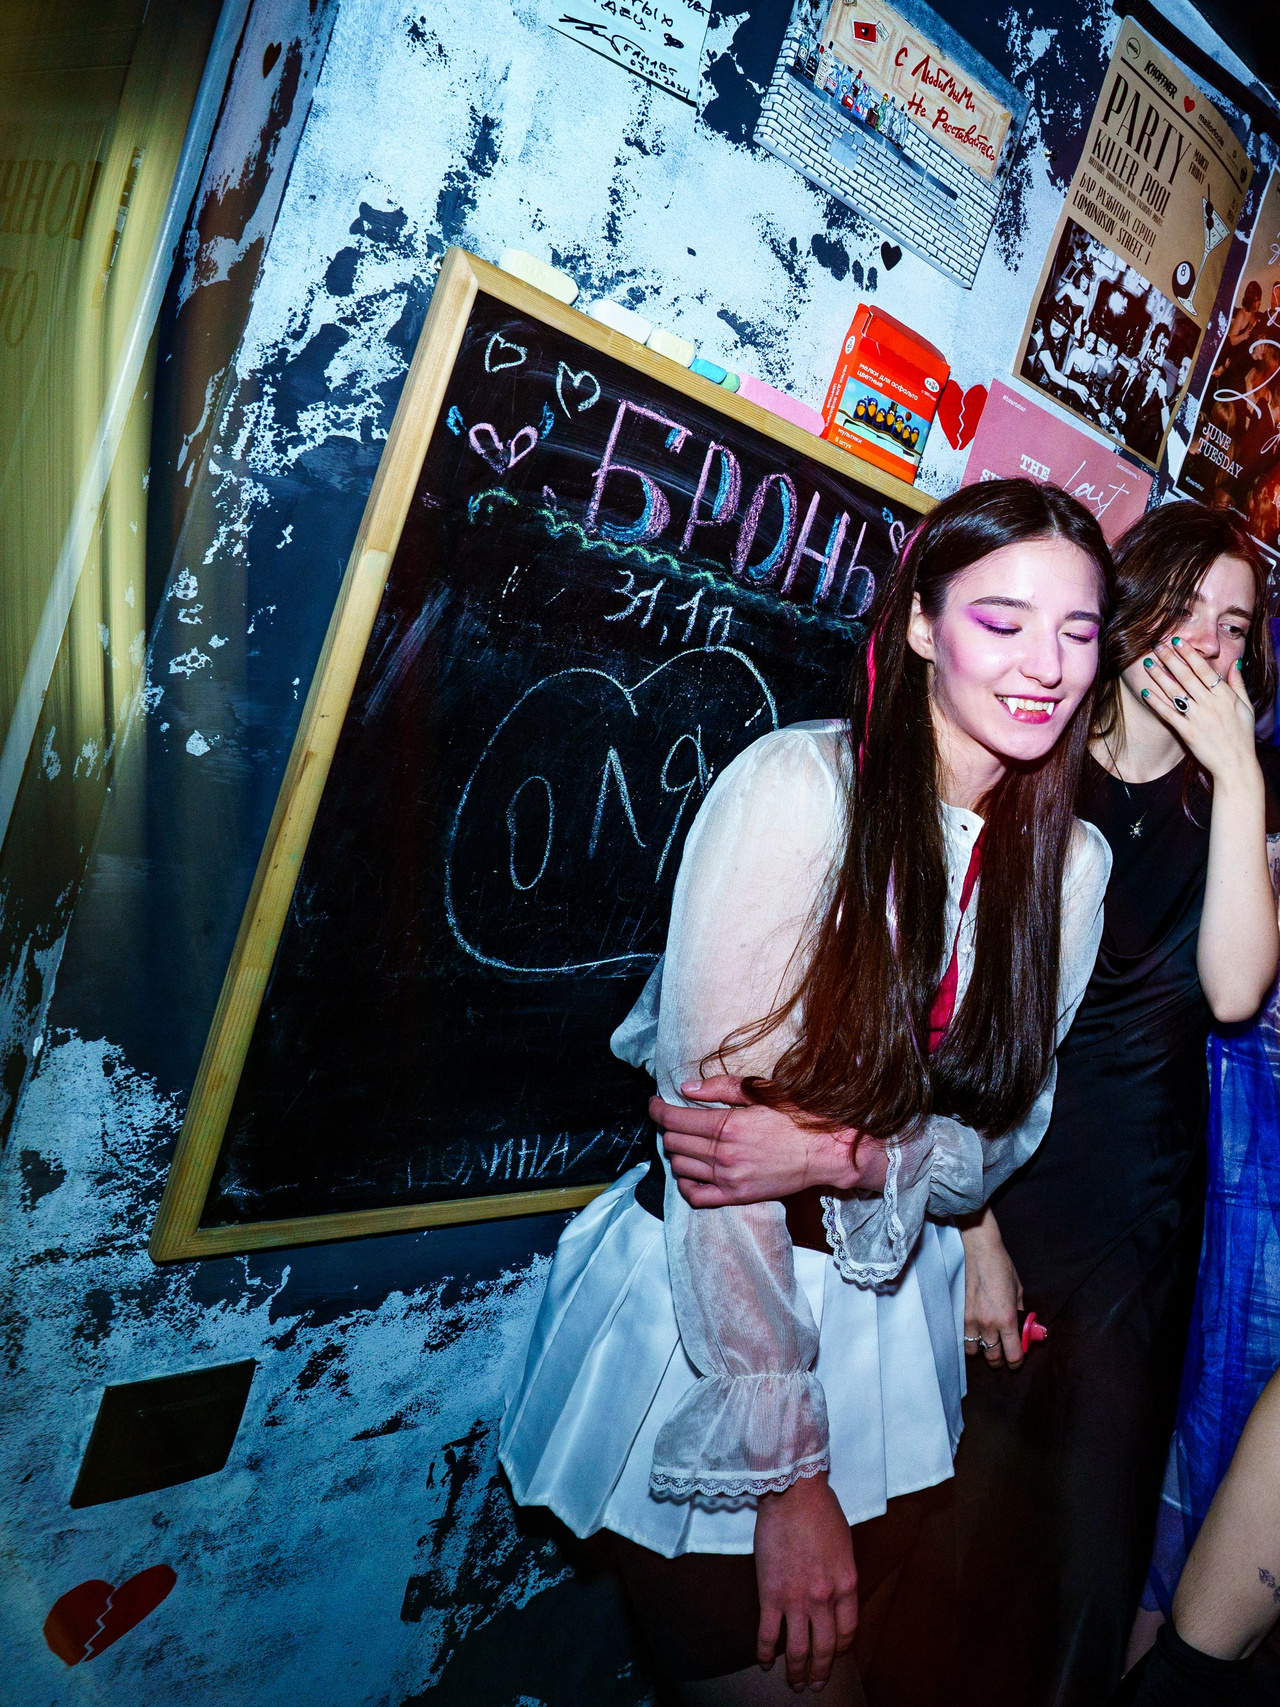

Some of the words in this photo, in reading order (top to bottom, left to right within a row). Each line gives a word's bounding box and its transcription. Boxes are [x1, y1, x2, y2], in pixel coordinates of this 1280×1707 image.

[907, 92, 927, 117] Не
[1101, 72, 1192, 186] PARTY
[1092, 128, 1140, 190] KILLER
[1139, 172, 1171, 219] POOL
[1072, 190, 1118, 236] LOMONOSOV
[1144, 251, 1151, 265] 1
[1079, 172, 1097, 194] БАР
[1095, 186, 1133, 227] РАЗБИТЫХ
[1131, 217, 1157, 248] СЕРДЕЦ
[1180, 264, 1187, 277] 8
[857, 370, 883, 388] цветные
[859, 363, 880, 379] мелки
[879, 375, 892, 385] для
[1202, 422, 1232, 451] JUNE
[1020, 454, 1050, 482] THE
[1198, 437, 1243, 479] TUESDAY
[586, 399, 877, 620] БРОНЬ
[506, 725, 710, 890] ОЛЯ
